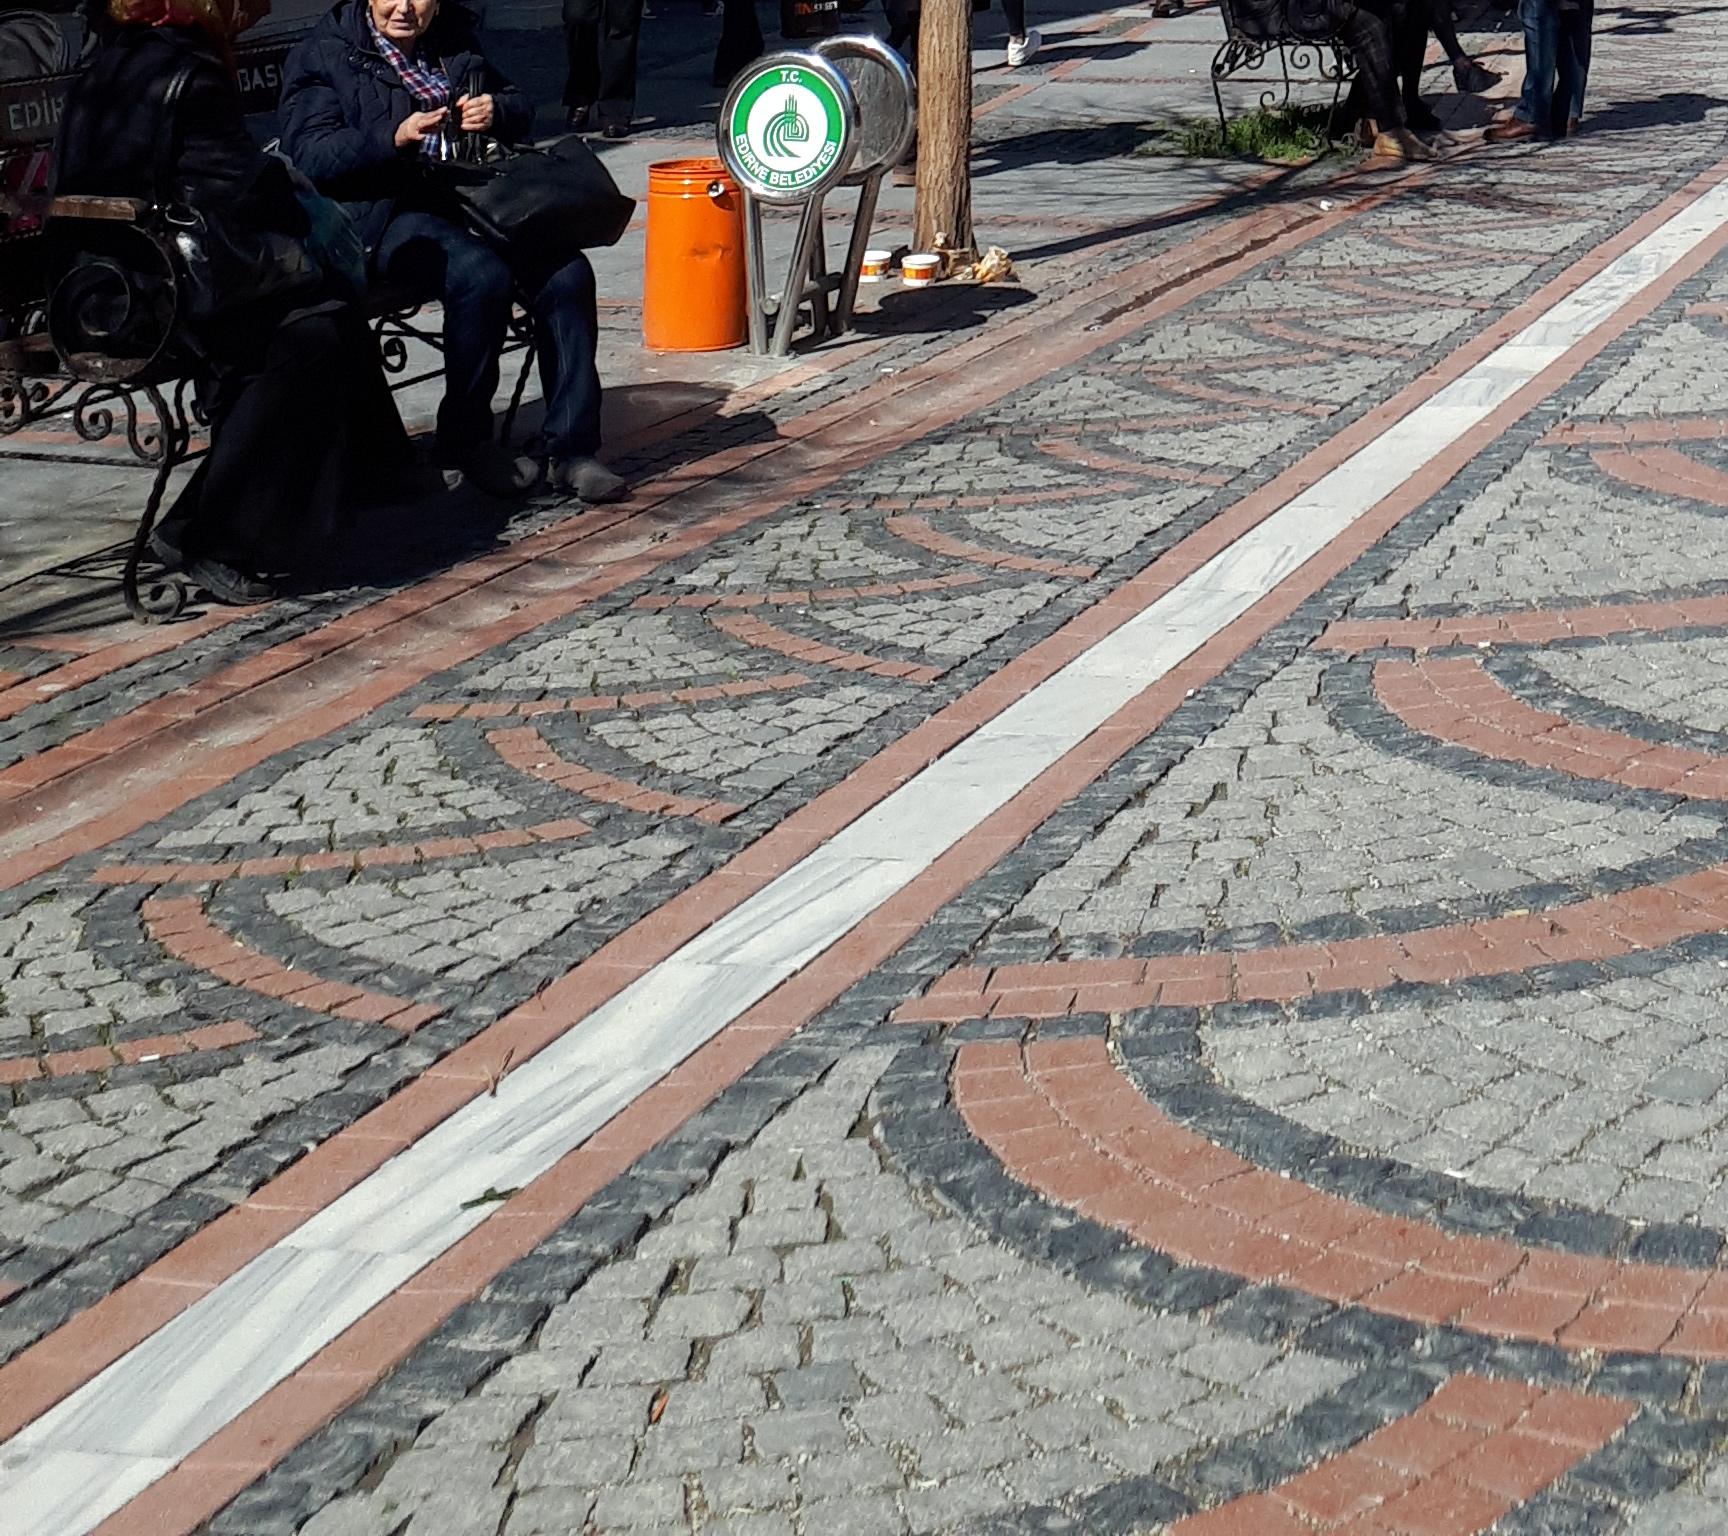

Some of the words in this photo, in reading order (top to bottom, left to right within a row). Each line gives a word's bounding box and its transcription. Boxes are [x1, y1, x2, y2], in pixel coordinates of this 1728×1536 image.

[780, 70, 803, 83] T.C.
[735, 133, 770, 180] EDİRNE
[769, 140, 838, 187] BELEDİYESİ
